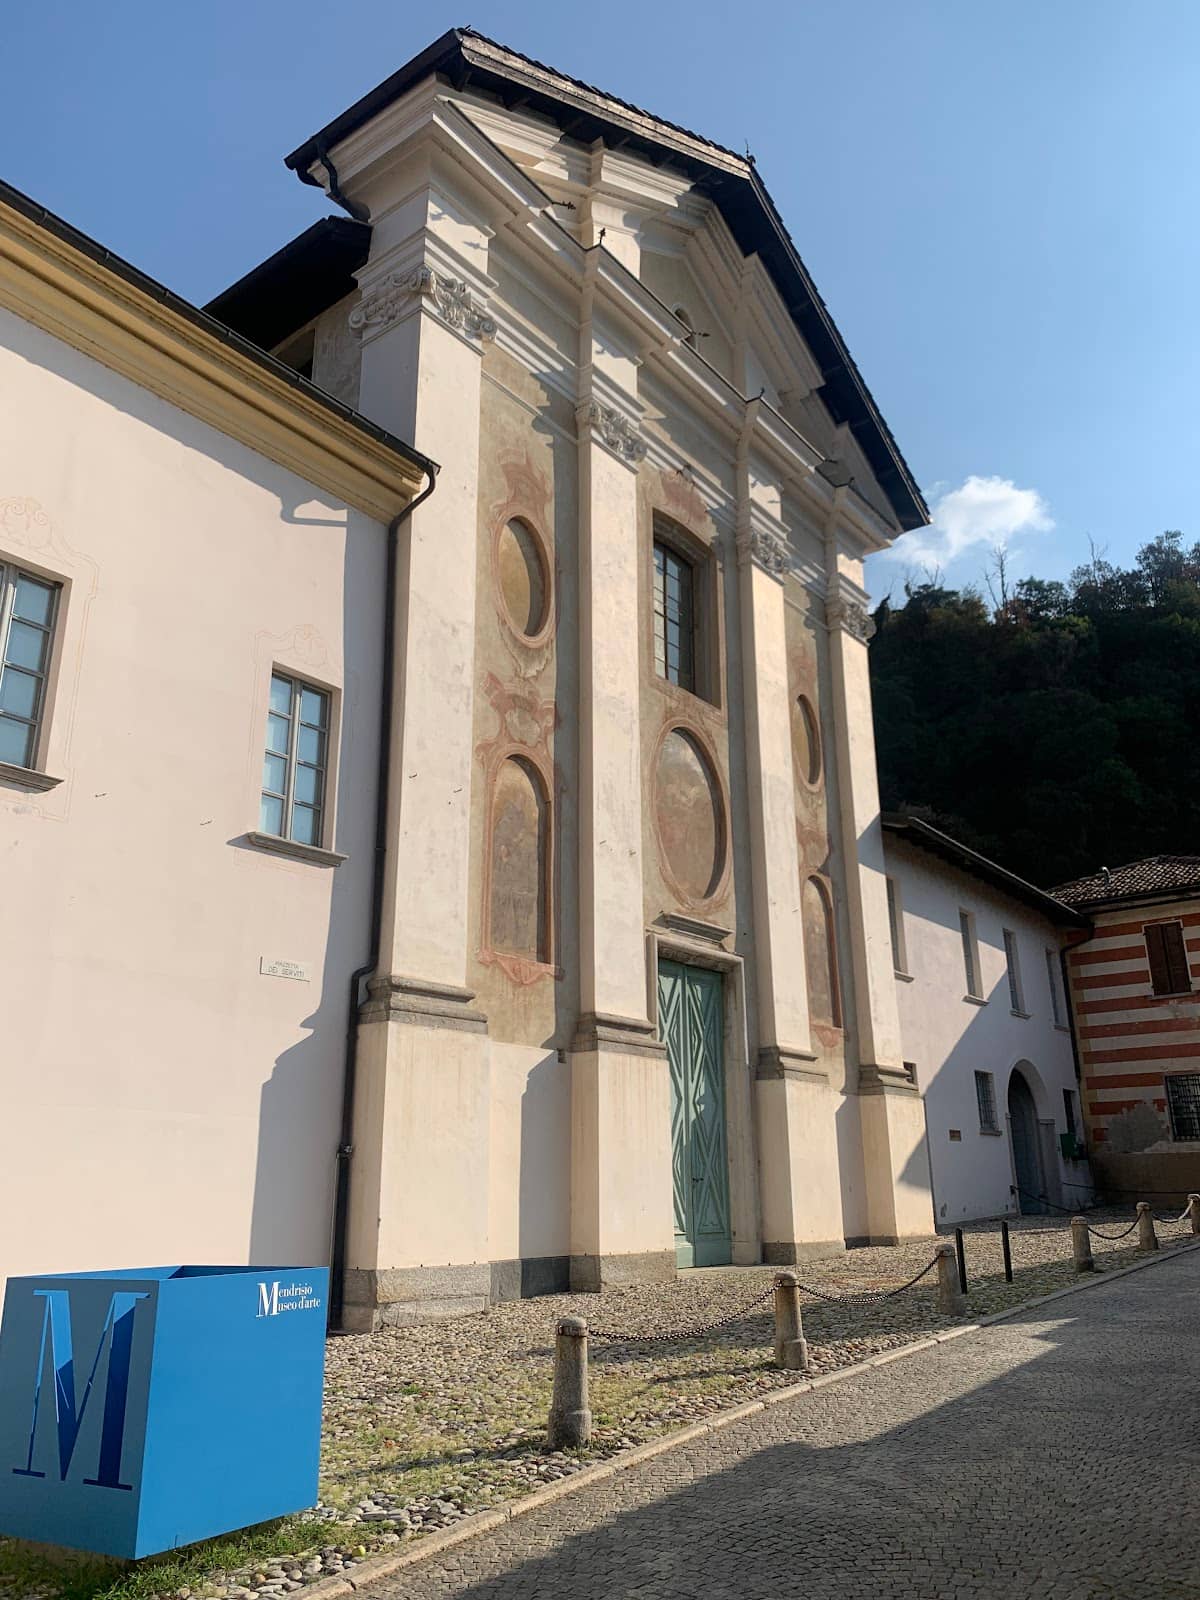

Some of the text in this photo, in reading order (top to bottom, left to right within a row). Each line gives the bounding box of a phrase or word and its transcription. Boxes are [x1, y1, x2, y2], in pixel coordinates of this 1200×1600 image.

[256, 1281, 313, 1318] Mendrisio
[298, 1295, 321, 1310] d'arte
[12, 1289, 151, 1491] M
